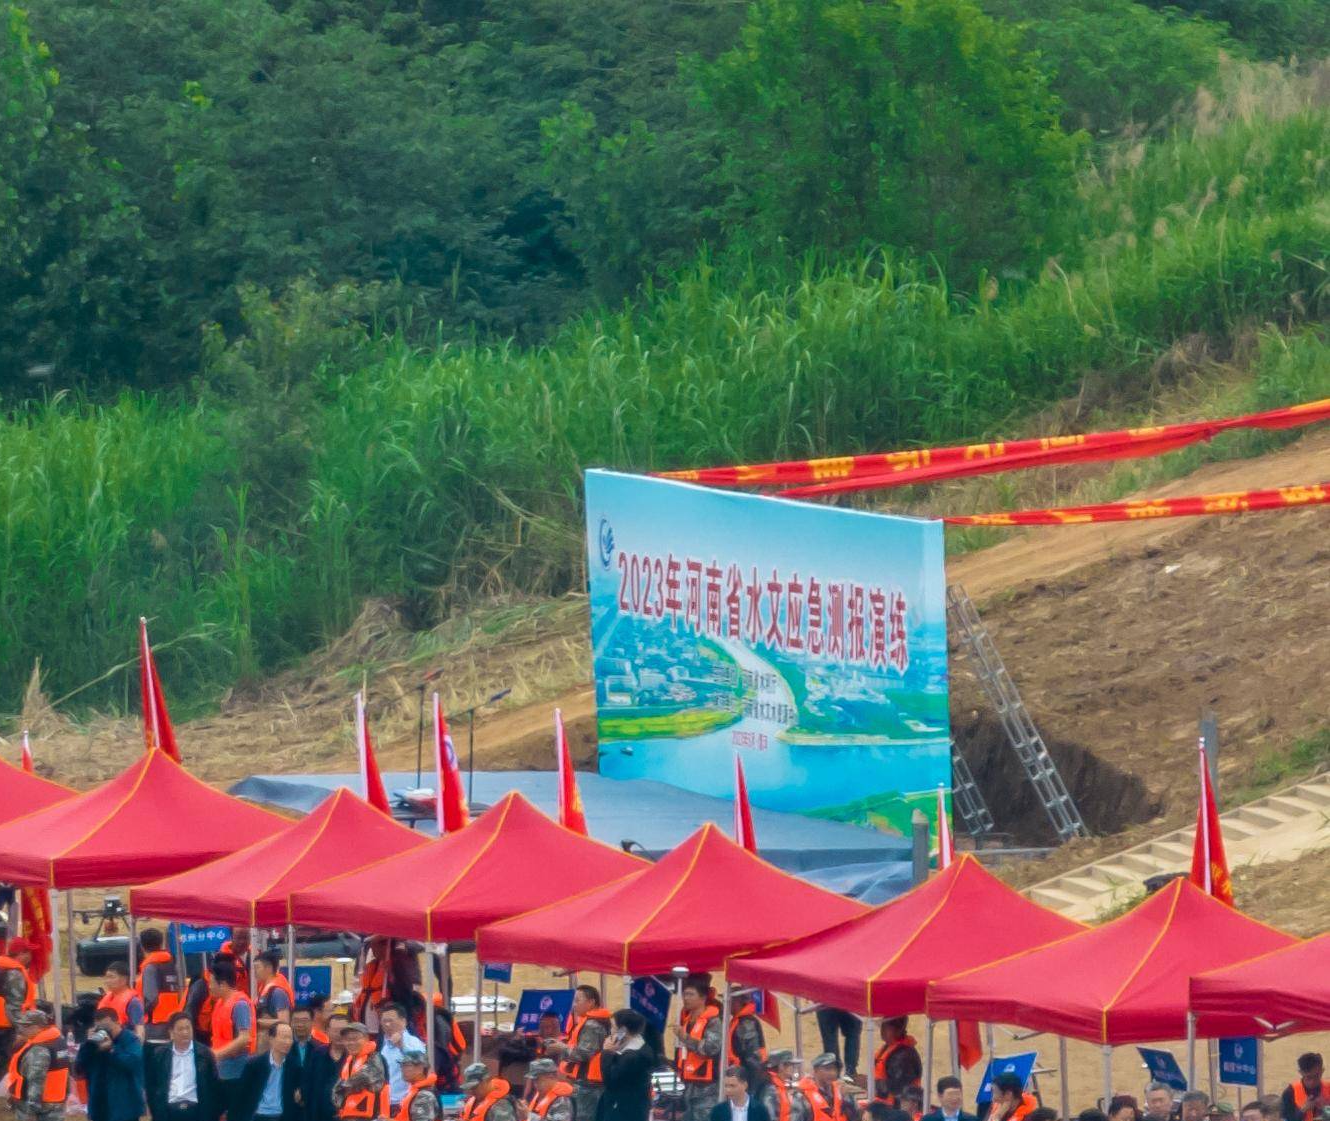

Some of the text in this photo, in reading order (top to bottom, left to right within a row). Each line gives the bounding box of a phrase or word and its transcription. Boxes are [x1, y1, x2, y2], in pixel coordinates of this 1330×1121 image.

[617, 550, 910, 673] 2023年河南省水文应急测报演练
